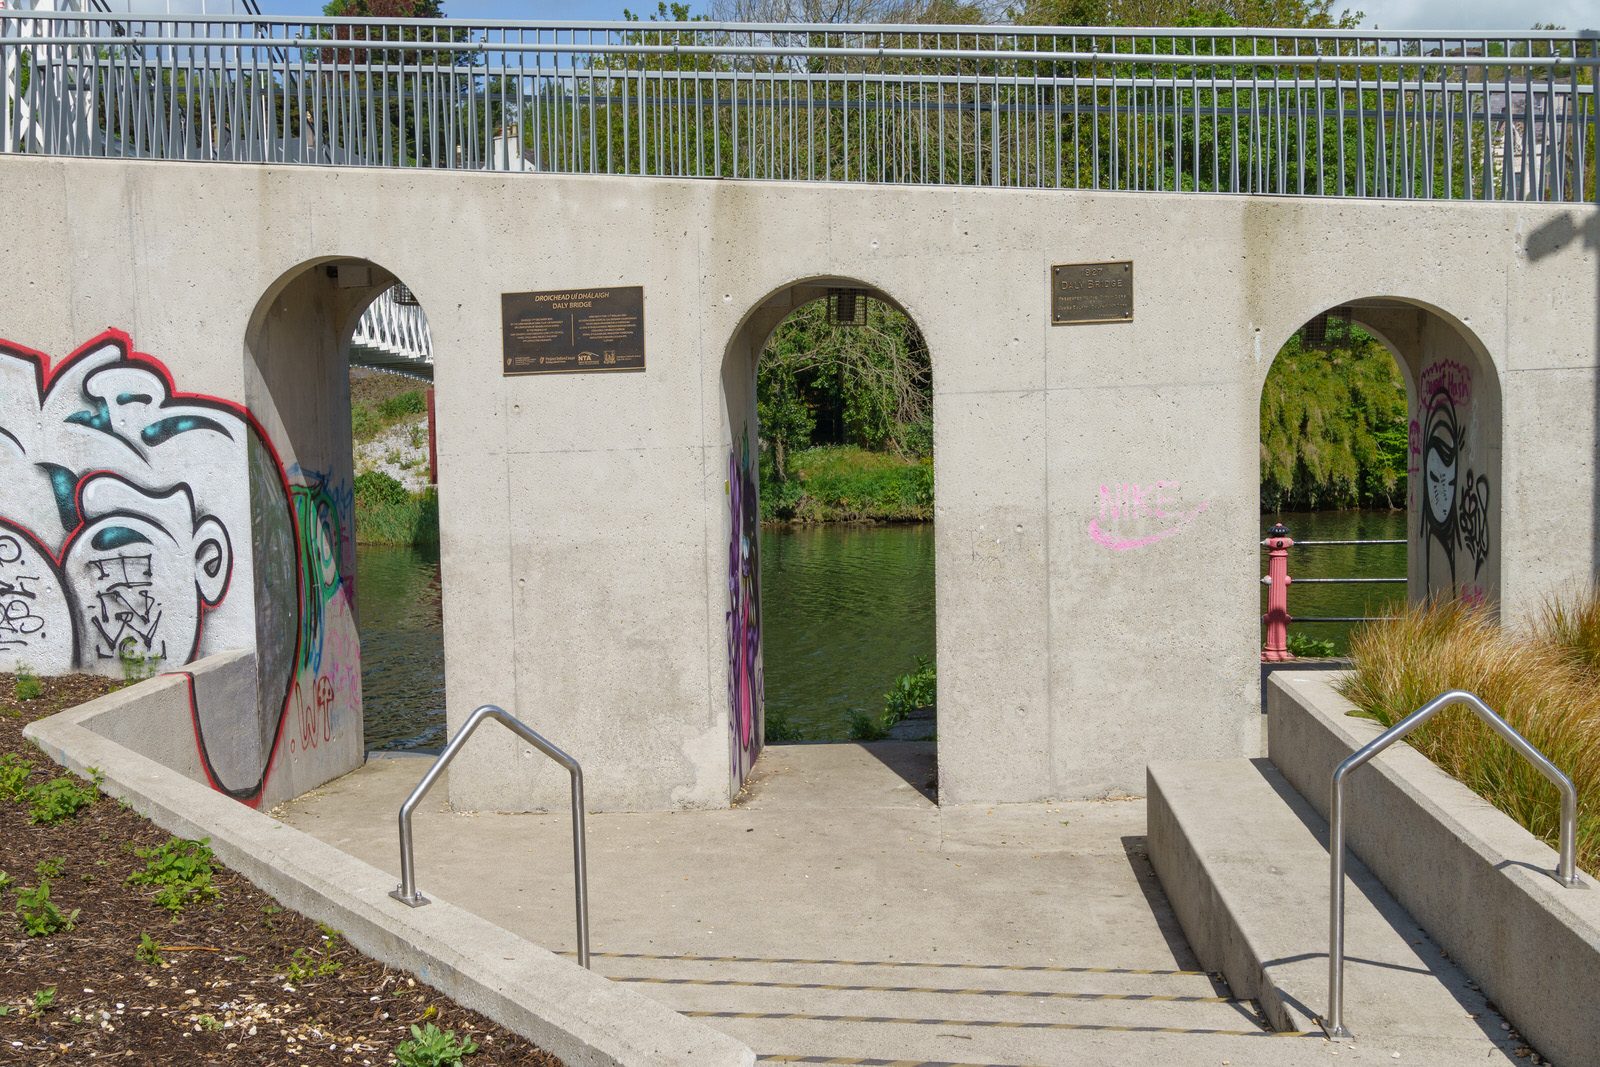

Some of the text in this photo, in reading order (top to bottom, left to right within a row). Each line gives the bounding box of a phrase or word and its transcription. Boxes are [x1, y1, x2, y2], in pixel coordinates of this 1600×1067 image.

[1061, 279, 1123, 290] DALY BRIDGE
[534, 294, 570, 302] DROICHEAD
